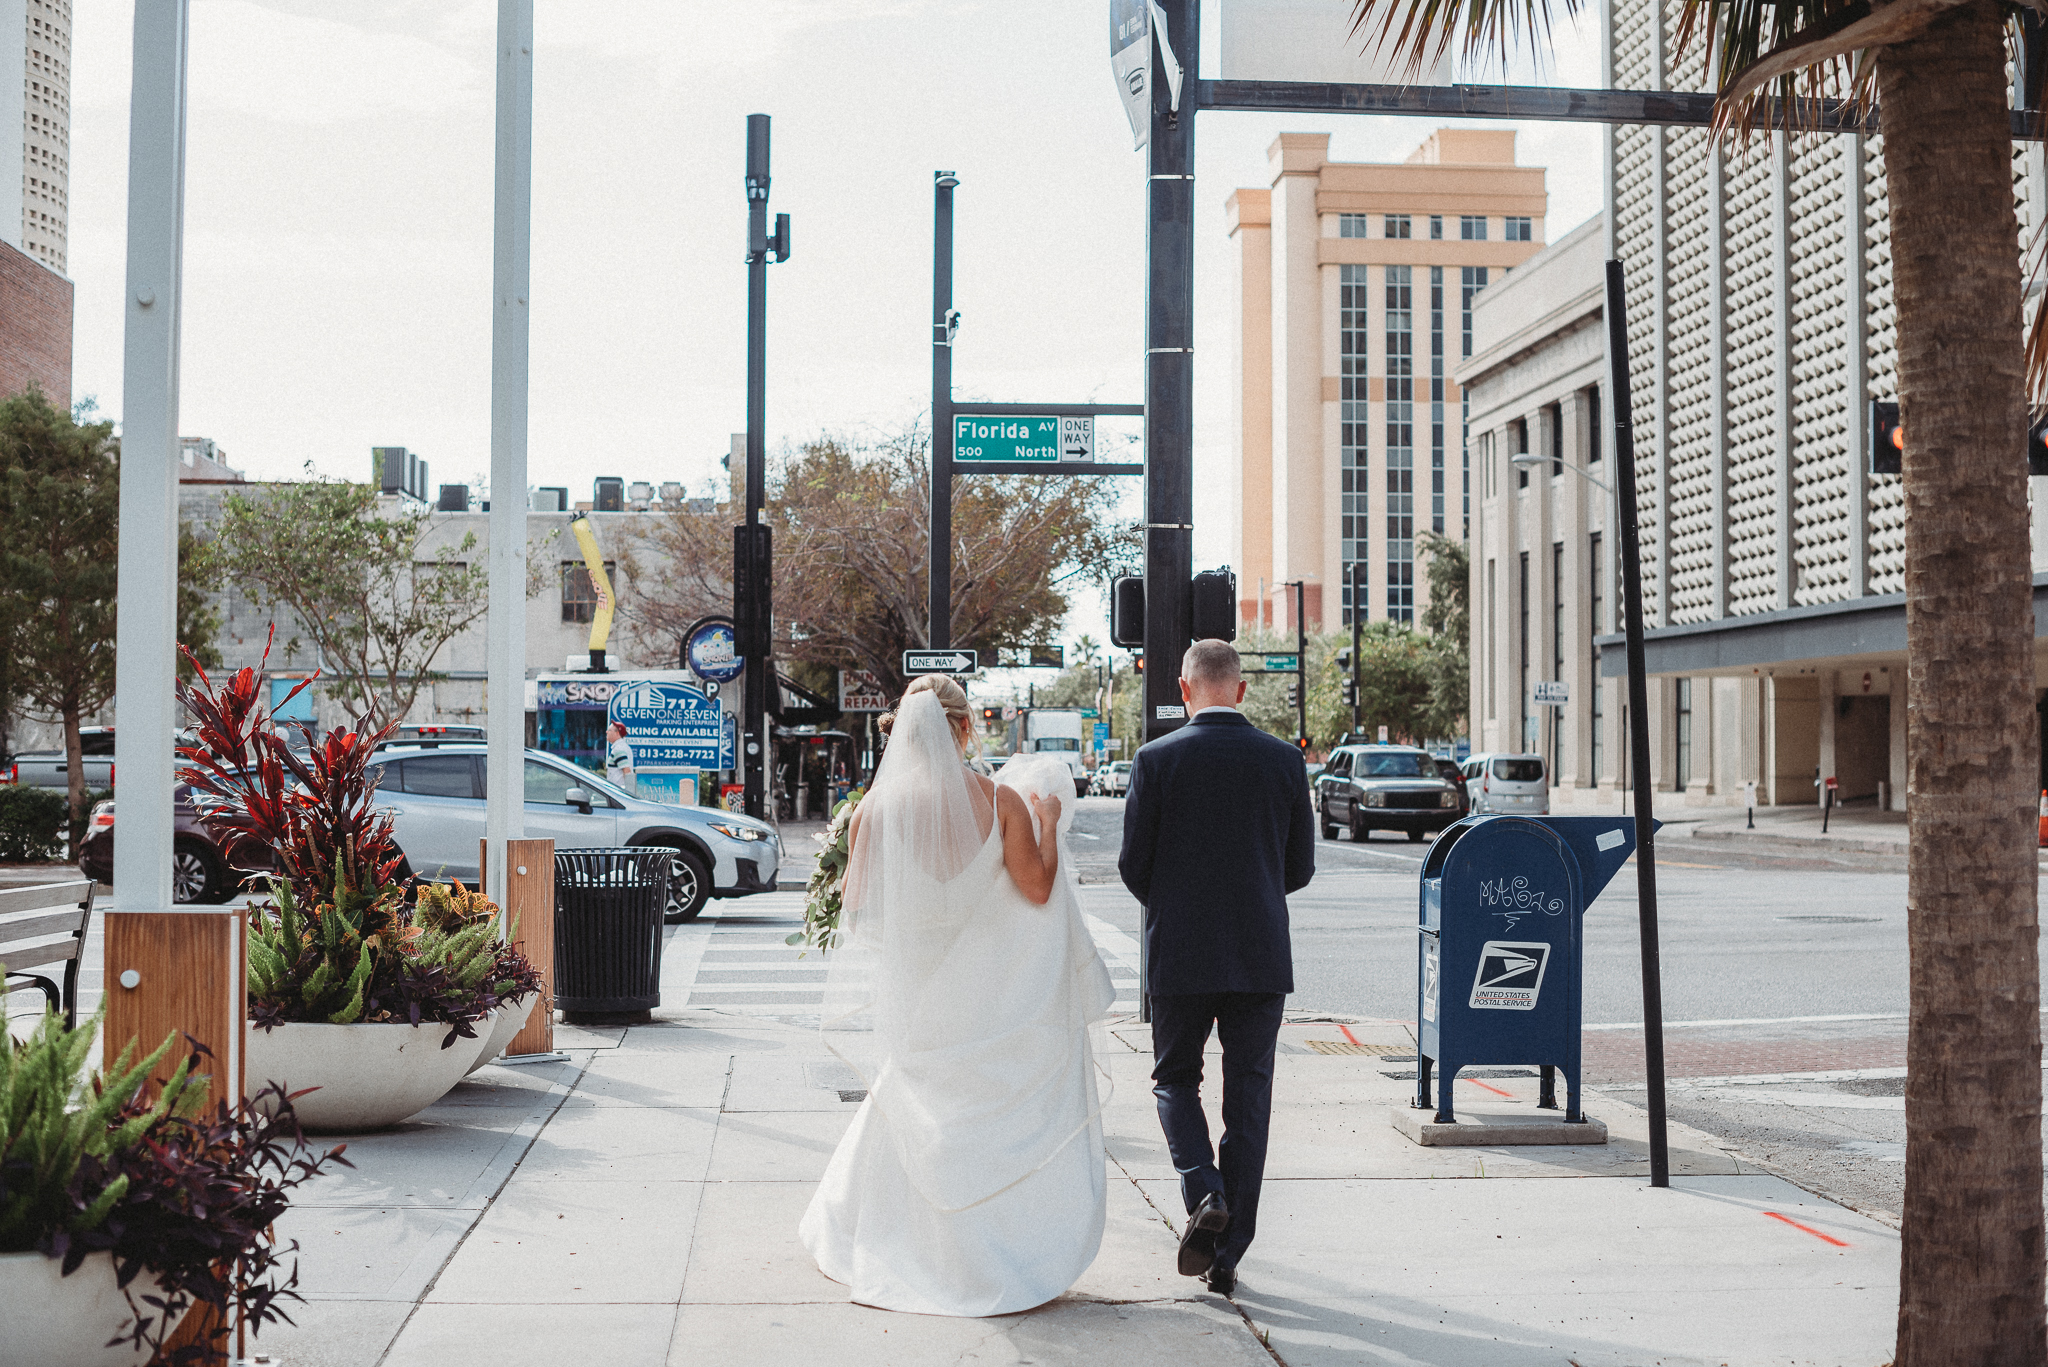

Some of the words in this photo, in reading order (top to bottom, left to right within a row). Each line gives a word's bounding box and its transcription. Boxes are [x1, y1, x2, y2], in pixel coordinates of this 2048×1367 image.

[958, 422, 1030, 438] Florida
[1038, 422, 1055, 432] AV
[1065, 420, 1090, 431] ONE
[1064, 433, 1091, 444] WAY
[958, 447, 982, 456] 500
[1015, 446, 1056, 457] North
[912, 658, 930, 667] ONE
[934, 658, 954, 667] WAY
[706, 682, 718, 697] P
[667, 699, 698, 709] 717
[727, 711, 733, 719] P
[626, 727, 659, 736] RKING
[661, 728, 719, 737] AVAILABLE
[639, 748, 715, 759] 813-228-7722
